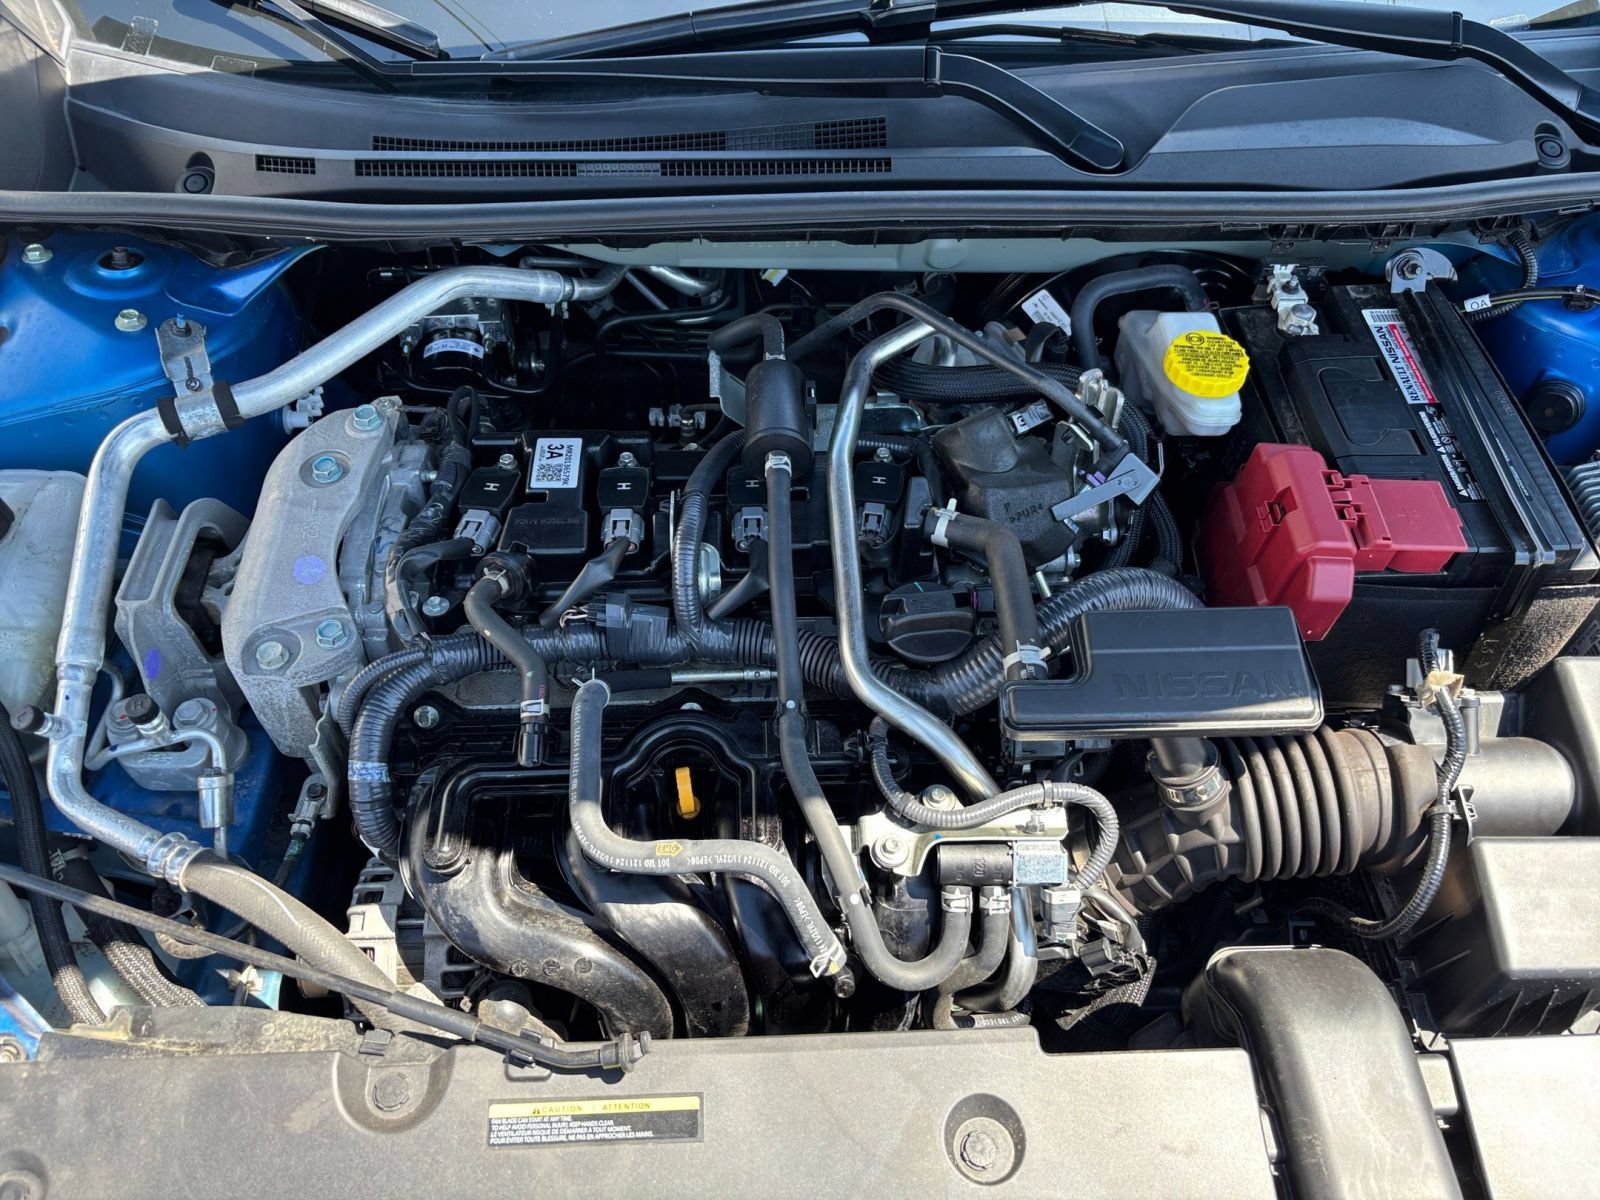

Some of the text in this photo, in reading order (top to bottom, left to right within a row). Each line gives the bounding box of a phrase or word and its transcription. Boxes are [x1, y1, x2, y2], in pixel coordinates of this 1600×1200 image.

[1374, 326, 1400, 363] NISSAN
[1395, 365, 1420, 401] RENAULT
[546, 444, 564, 460] 3A
[1113, 671, 1302, 700] NISSAN
[543, 1105, 582, 1113] CAUTION
